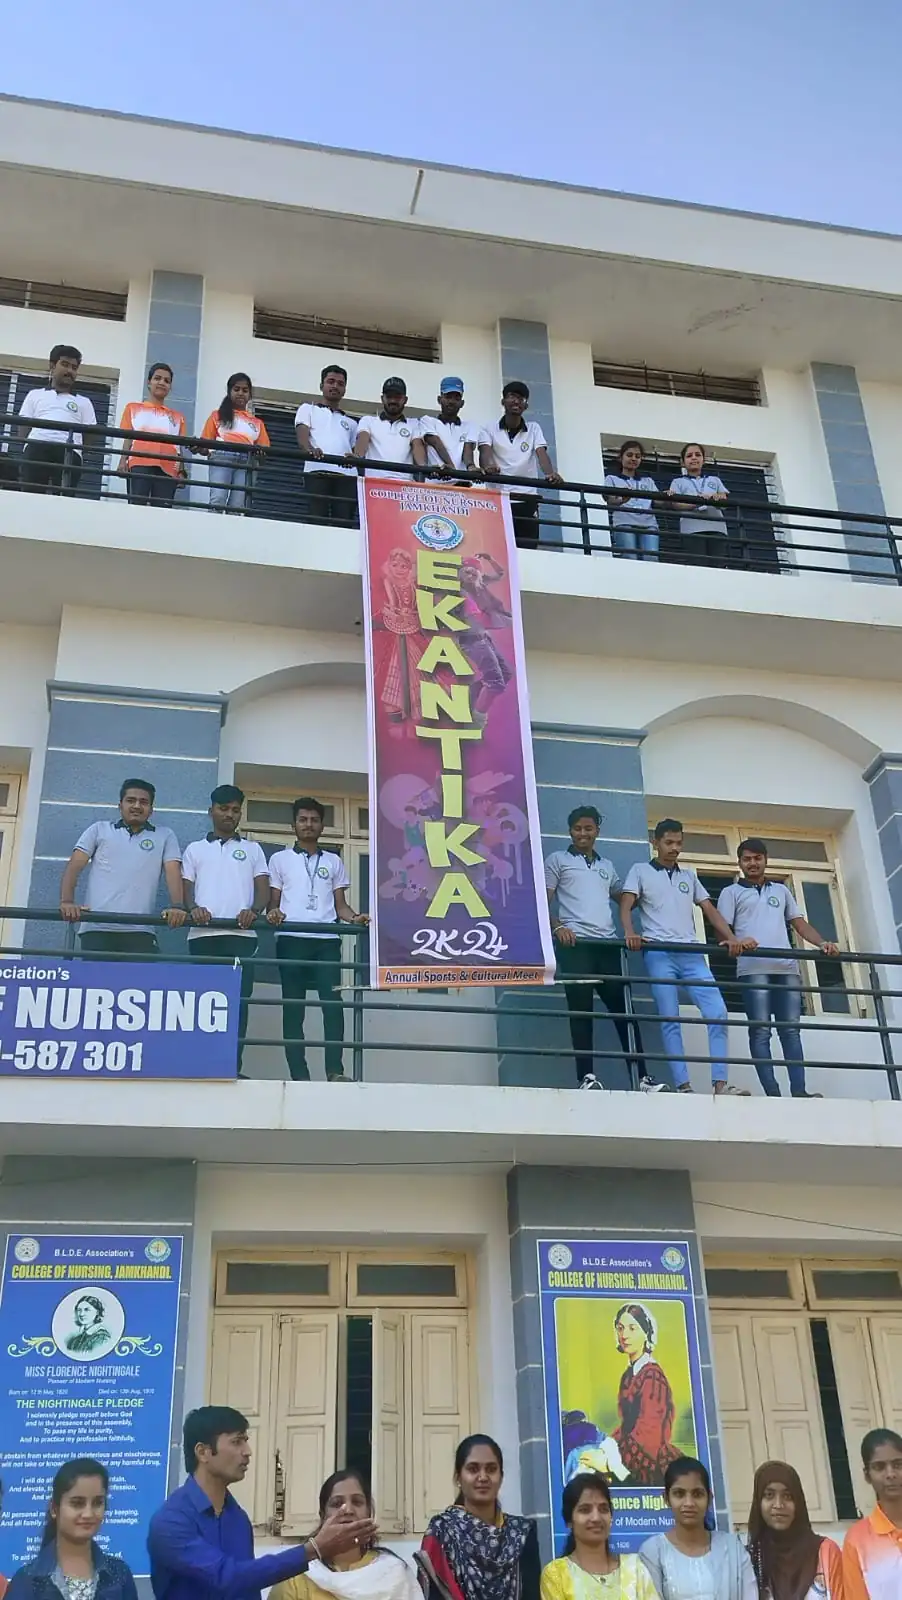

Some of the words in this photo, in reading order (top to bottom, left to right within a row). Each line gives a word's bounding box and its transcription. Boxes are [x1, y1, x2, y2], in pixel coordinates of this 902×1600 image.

[424, 494, 440, 504] OF
[399, 500, 471, 516] JAMKHANDI
[416, 549, 491, 918] EKANTIKA
[0, 966, 70, 981] ciation's
[385, 970, 421, 983] Annual
[423, 970, 457, 983] Sports
[459, 970, 469, 981] &
[471, 970, 510, 981] Cultural
[512, 970, 539, 980] Meet
[15, 986, 229, 1033] NURSING
[0, 1040, 78, 1071] -587
[83, 1041, 143, 1071] 301
[54, 1249, 83, 1257] B.L.D.E.
[85, 1248, 134, 1257] Association's
[582, 1257, 608, 1266] B.L.D.E.
[609, 1258, 652, 1268] Association's
[12, 1264, 53, 1279] COLLEGE
[54, 1265, 67, 1279] OF
[68, 1265, 113, 1279] NURSING,
[548, 1270, 584, 1288] COLLEGE
[584, 1272, 596, 1288] OF
[596, 1272, 637, 1290] NURSING,
[25, 1366, 45, 1377] MISS
[47, 1366, 87, 1377] FLORENCE
[89, 1365, 140, 1377] NIGHTINGALE
[16, 1399, 35, 1408] THE
[37, 1398, 104, 1408] NIGHTINGALE
[105, 1398, 144, 1408] PLEDGE
[58, 1411, 79, 1420] pledge
[79, 1411, 100, 1419] myself
[12, 1511, 38, 1519] personal
[615, 1516, 623, 1526] of
[625, 1516, 657, 1526] Modern
[23, 1519, 42, 1528] family
